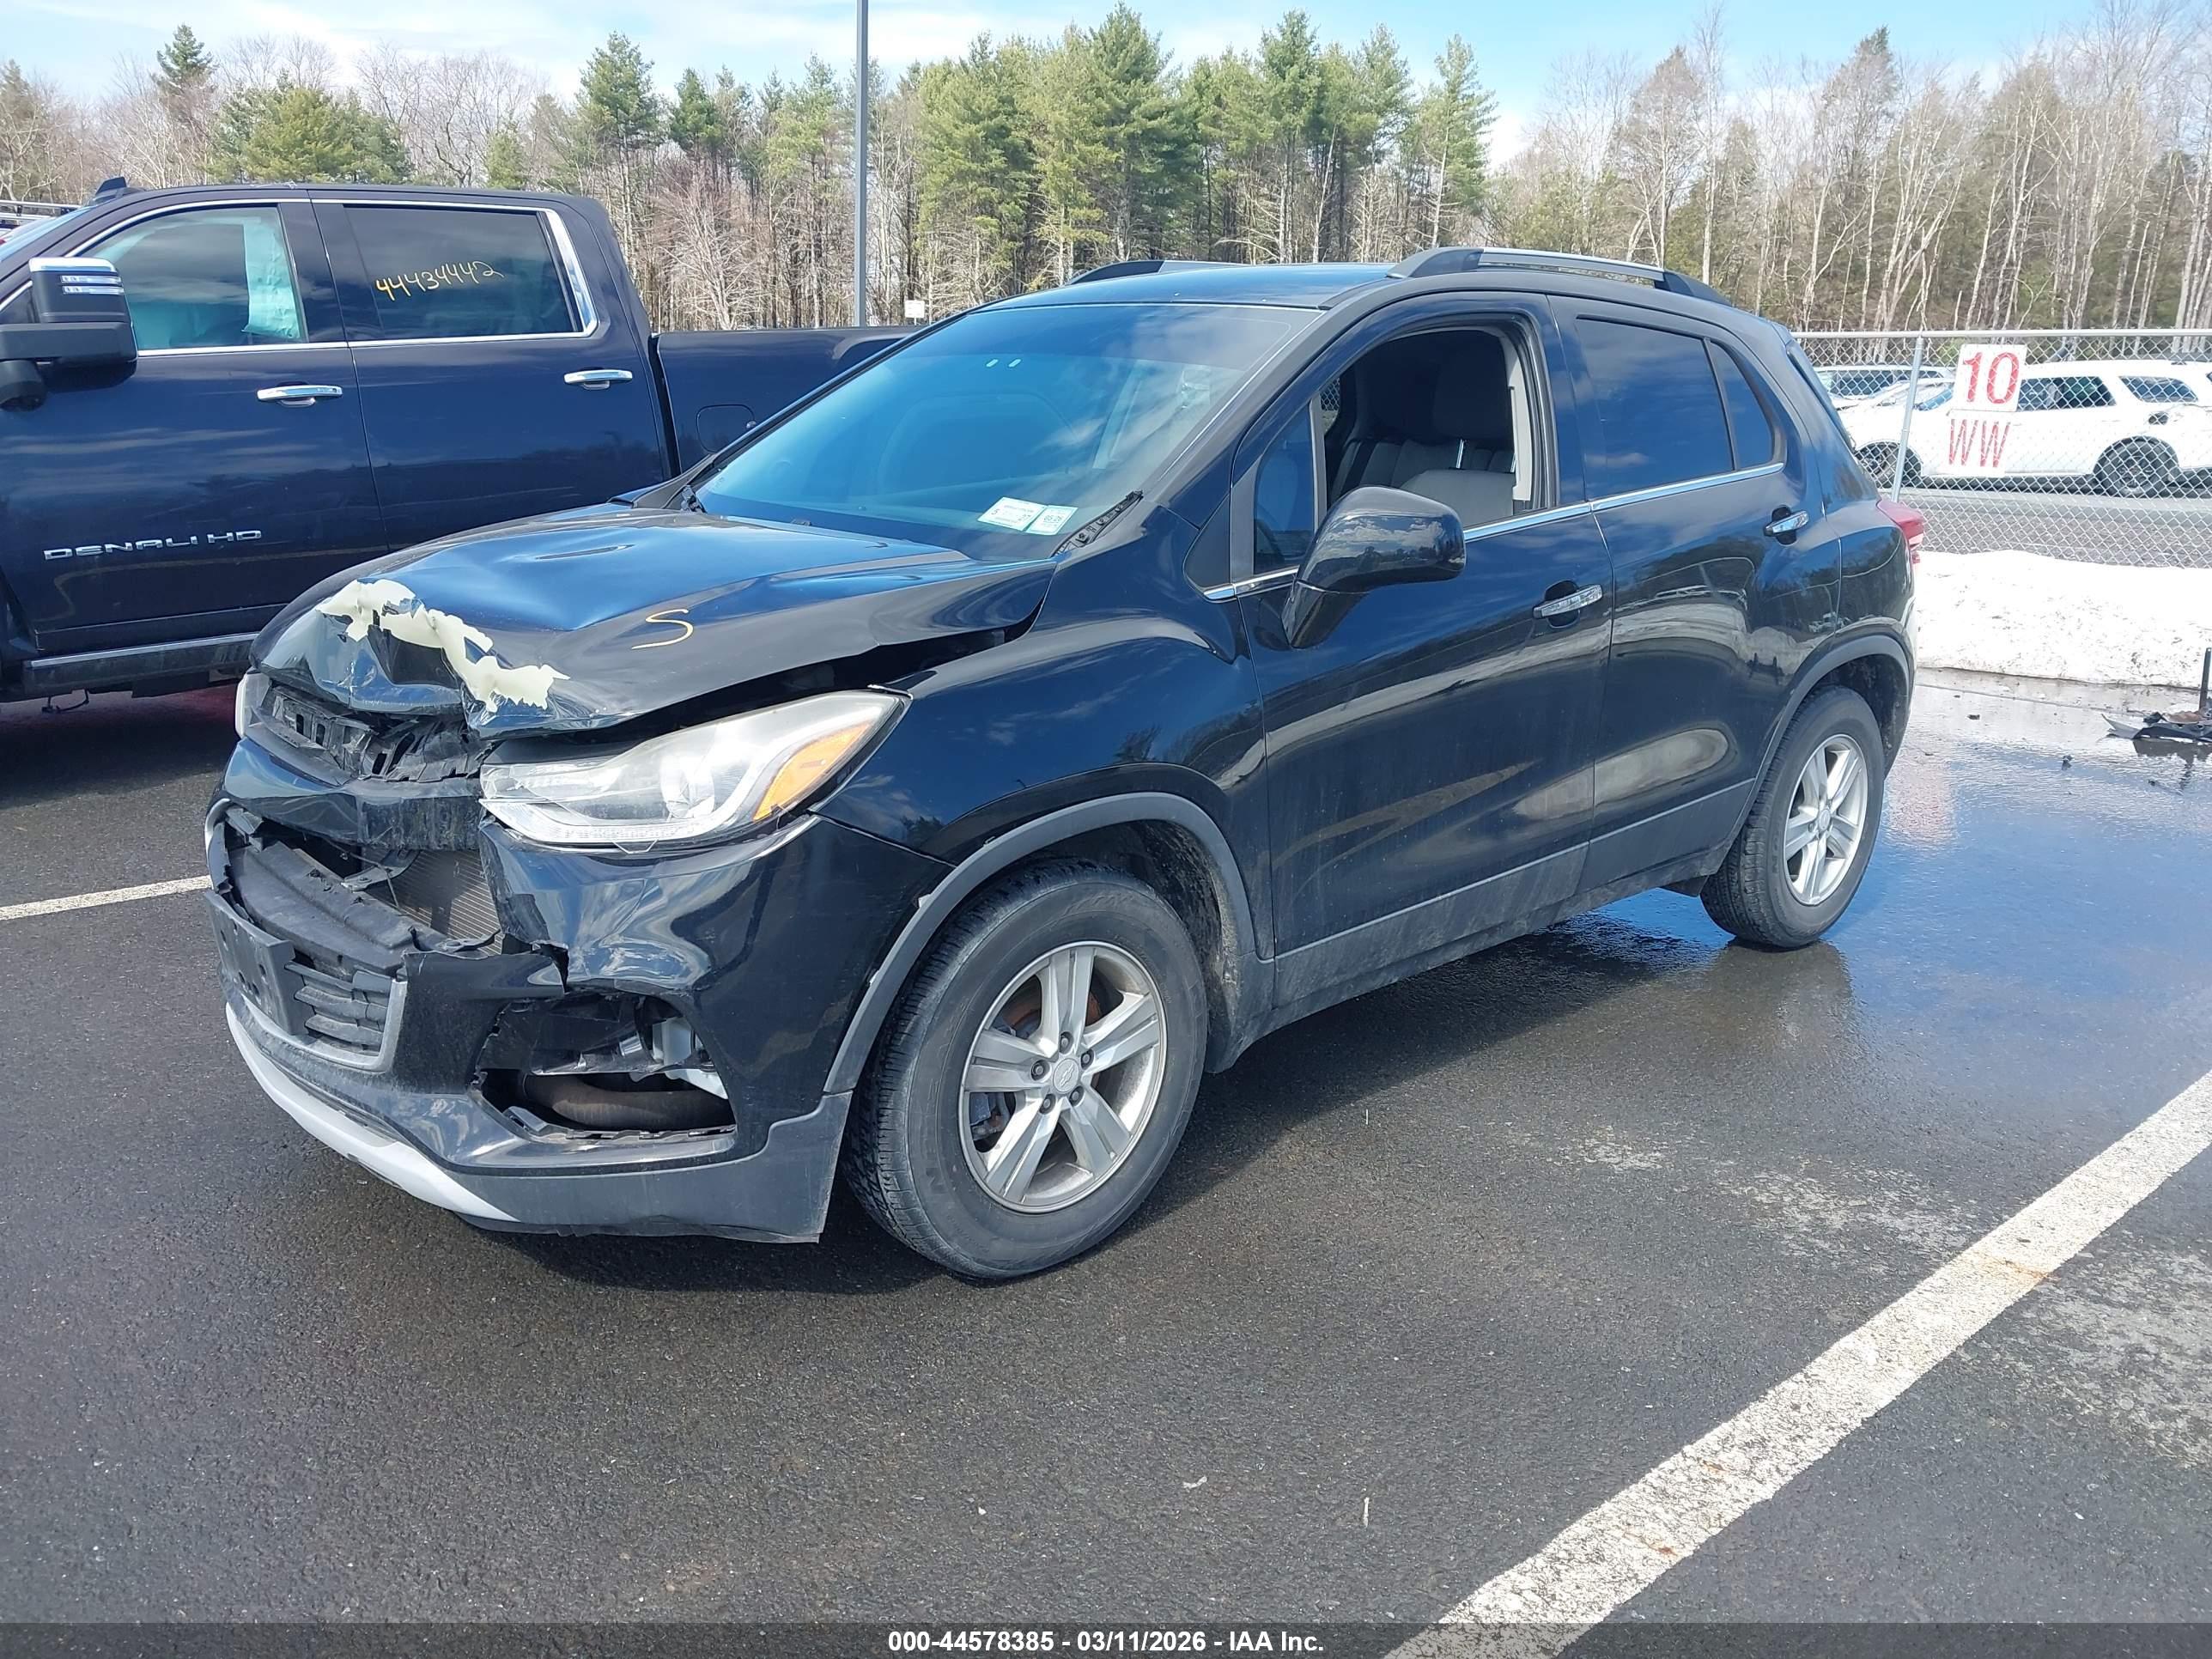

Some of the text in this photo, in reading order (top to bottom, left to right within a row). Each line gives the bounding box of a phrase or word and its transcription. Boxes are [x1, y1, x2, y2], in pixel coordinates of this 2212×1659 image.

[375, 260, 505, 301] 44434442
[1962, 351, 2020, 404] 10
[1948, 418, 2011, 468] WW
[44, 530, 262, 561] DENALI HD
[631, 608, 694, 650] S
